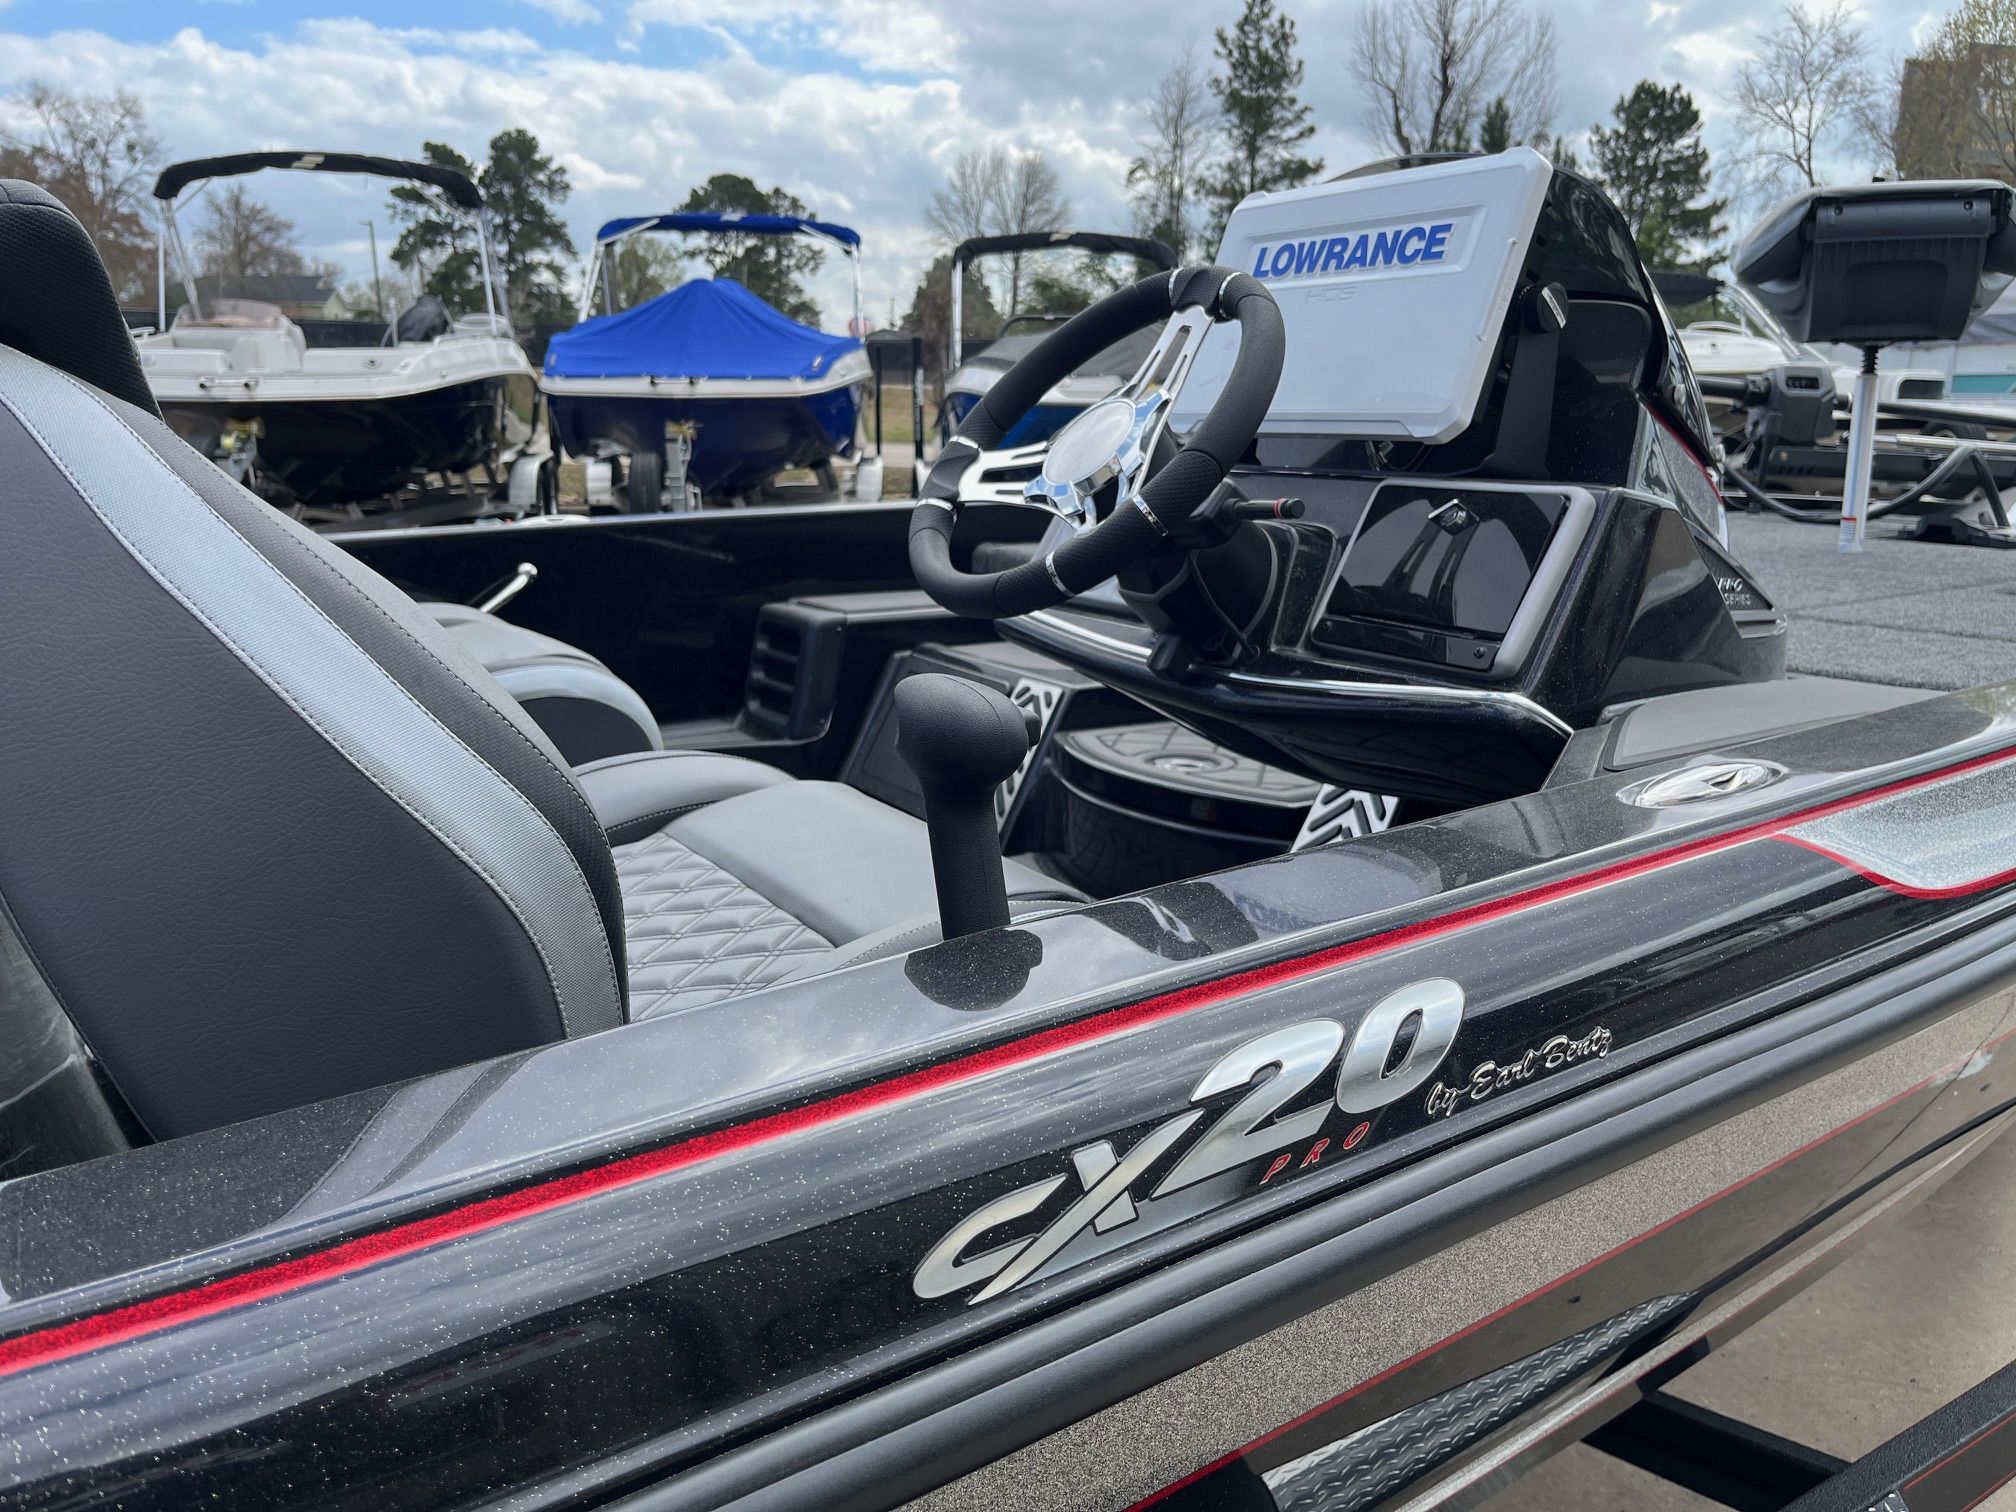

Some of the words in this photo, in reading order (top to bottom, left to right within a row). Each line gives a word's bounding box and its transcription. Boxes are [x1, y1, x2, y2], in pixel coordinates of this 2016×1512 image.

[1252, 223, 1453, 278] LOWRANCE
[1724, 593, 1751, 605] SERIES
[1425, 1082, 1462, 1117] by
[1470, 1050, 1535, 1100] Earl
[1542, 1026, 1612, 1069] Bentz
[1259, 1121, 1370, 1185] PRO
